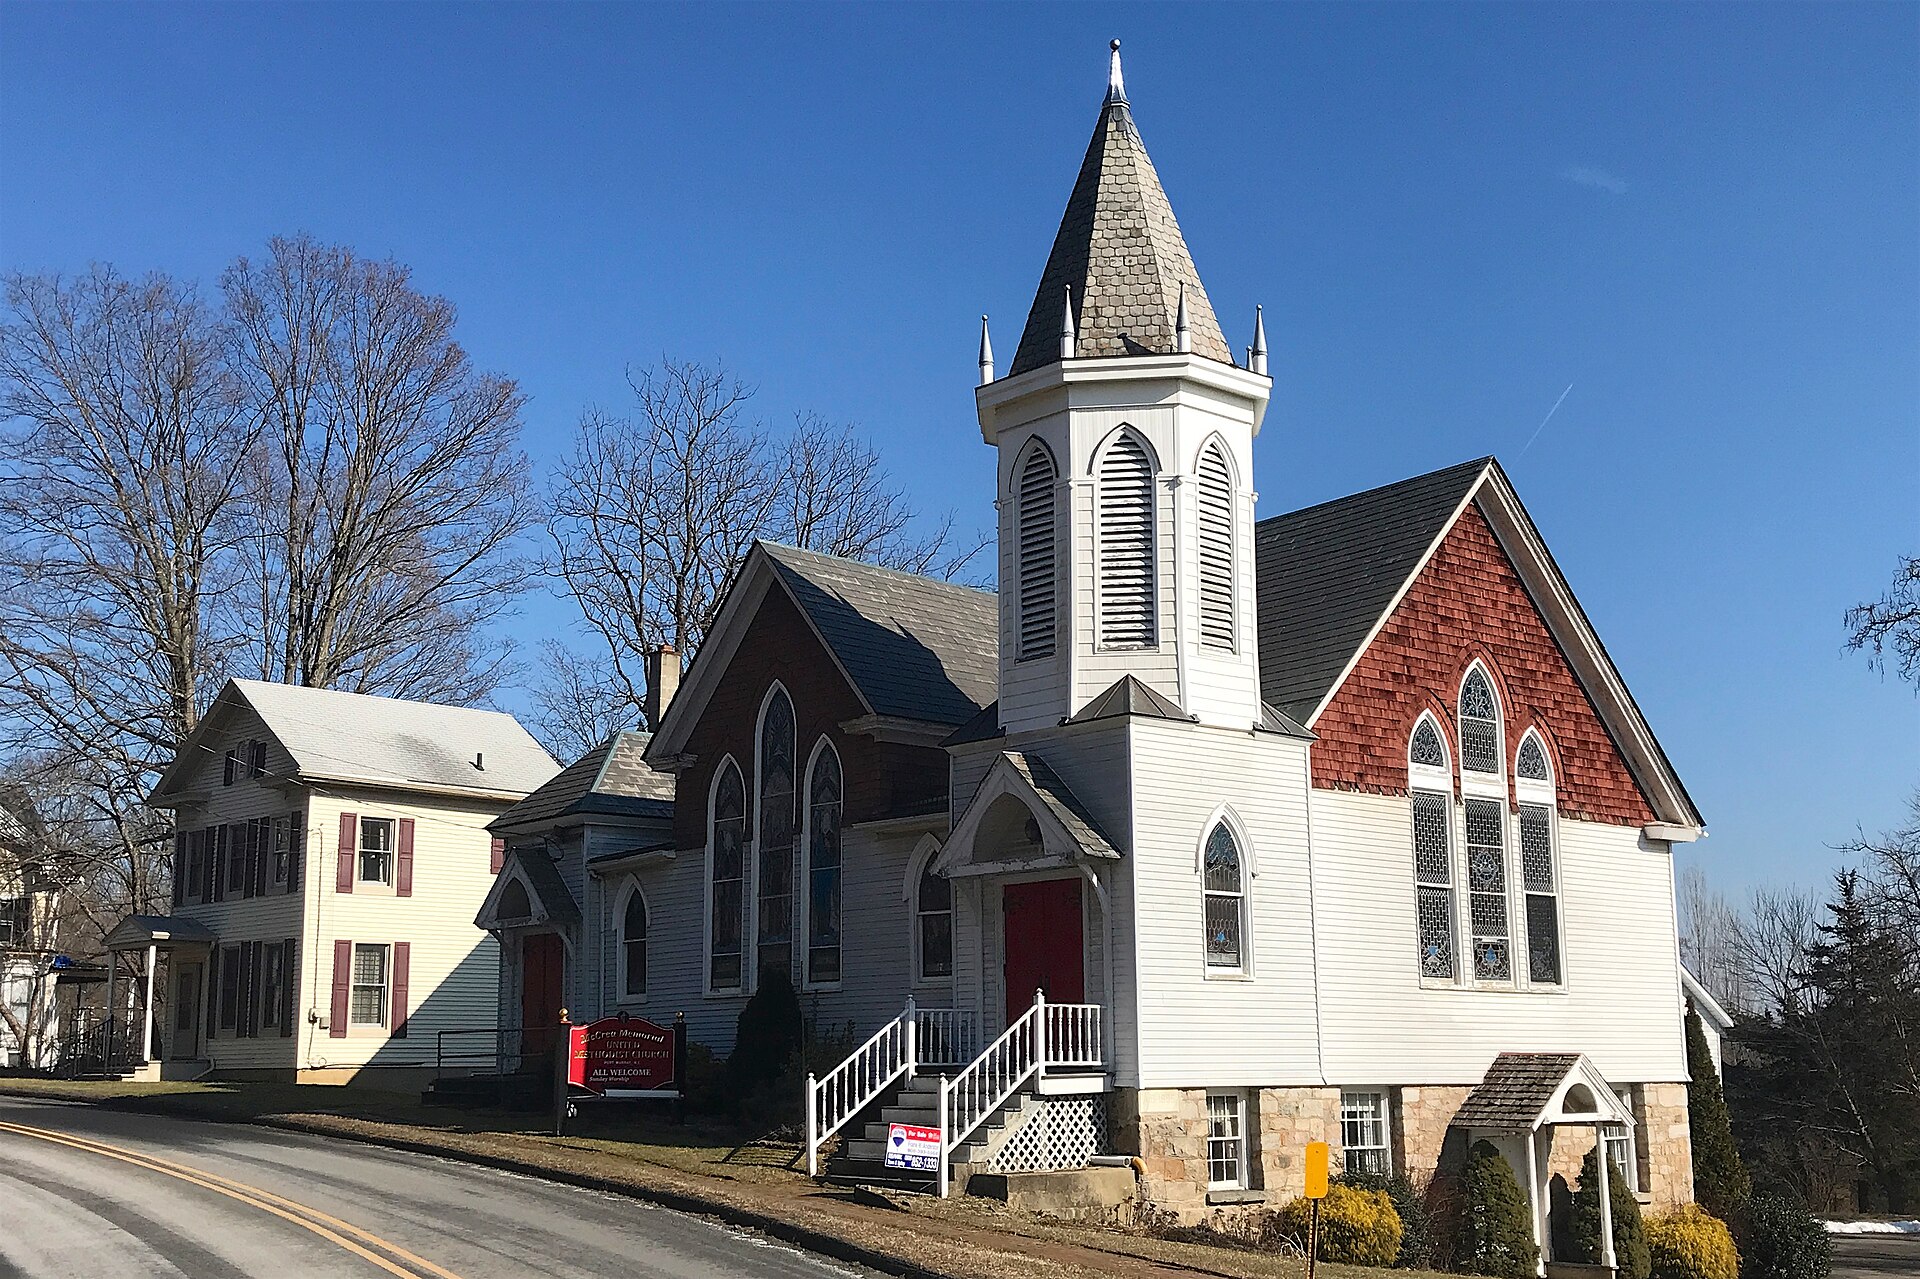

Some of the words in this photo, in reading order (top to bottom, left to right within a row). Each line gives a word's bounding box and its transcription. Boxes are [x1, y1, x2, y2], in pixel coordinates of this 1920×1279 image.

[619, 1029, 665, 1043] Memorial
[606, 1040, 641, 1049] UNITED
[574, 1050, 629, 1059] METHODIST
[631, 1050, 669, 1059] CHURCH
